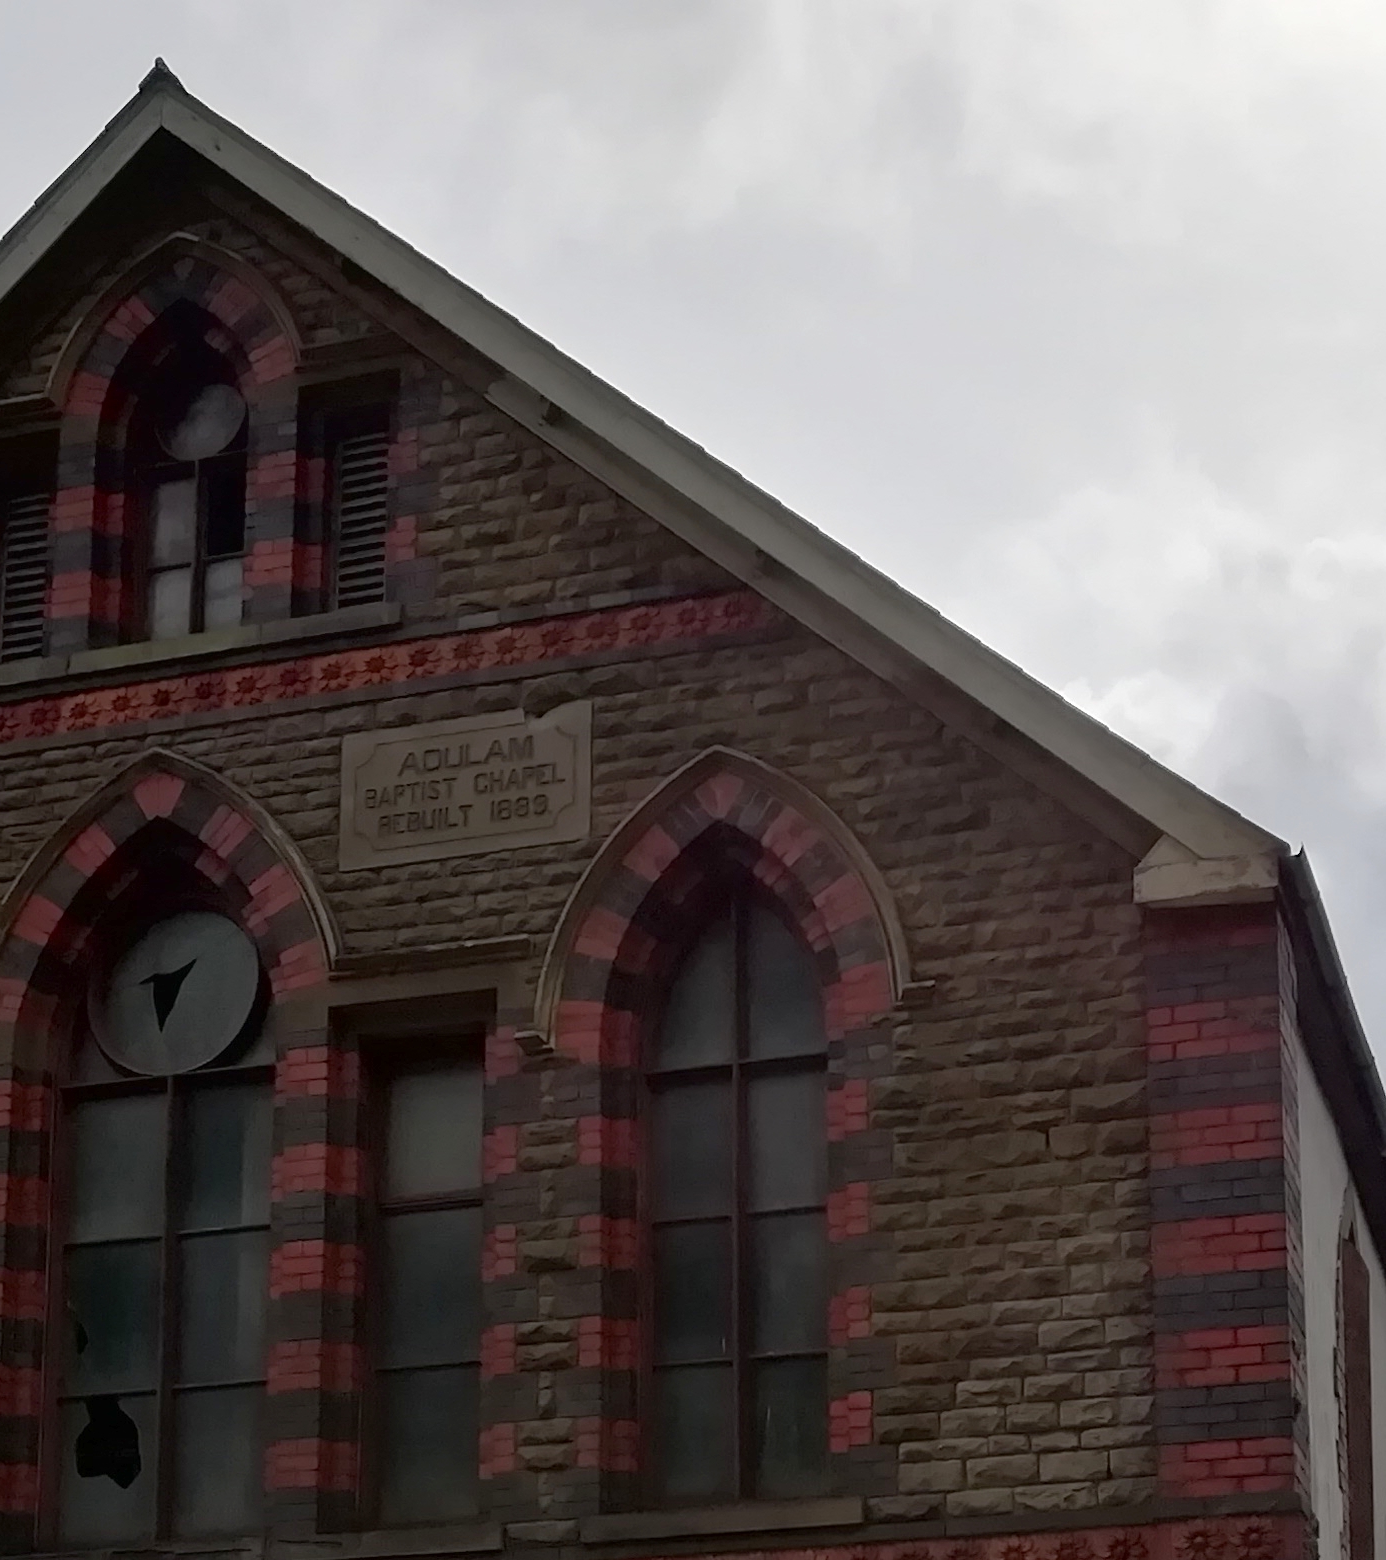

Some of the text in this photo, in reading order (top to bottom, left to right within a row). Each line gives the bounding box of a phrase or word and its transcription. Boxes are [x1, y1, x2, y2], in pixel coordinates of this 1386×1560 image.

[397, 735, 534, 776] ADULAM
[364, 762, 566, 809] BAPTIST CHAPEL
[378, 804, 473, 838] REBUILT
